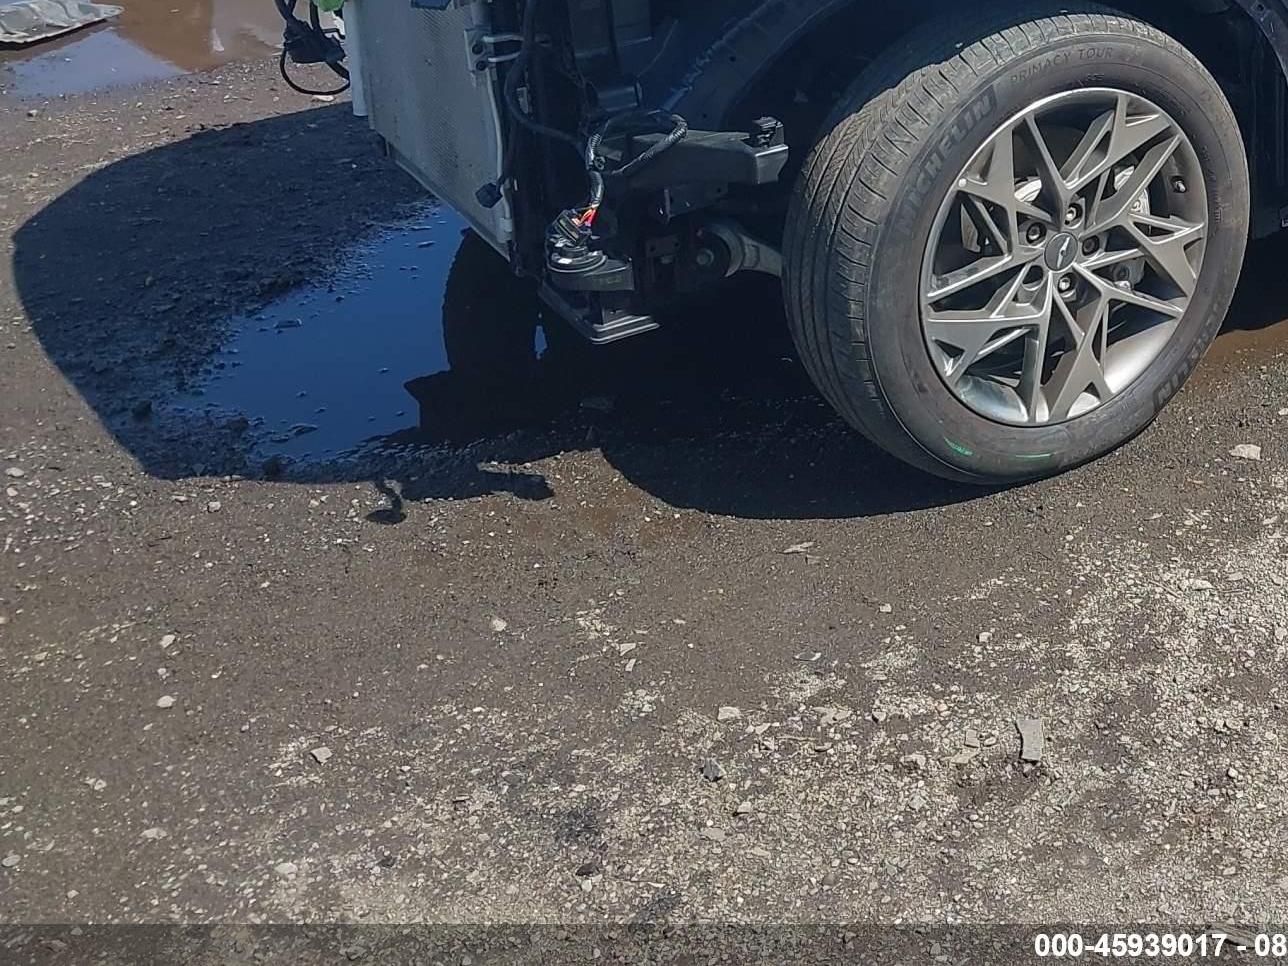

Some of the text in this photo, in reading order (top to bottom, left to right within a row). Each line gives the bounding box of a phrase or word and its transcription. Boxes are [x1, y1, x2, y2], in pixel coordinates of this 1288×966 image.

[1009, 46, 1113, 85] PRIMACY TOUR
[892, 93, 995, 234] MICHELIN
